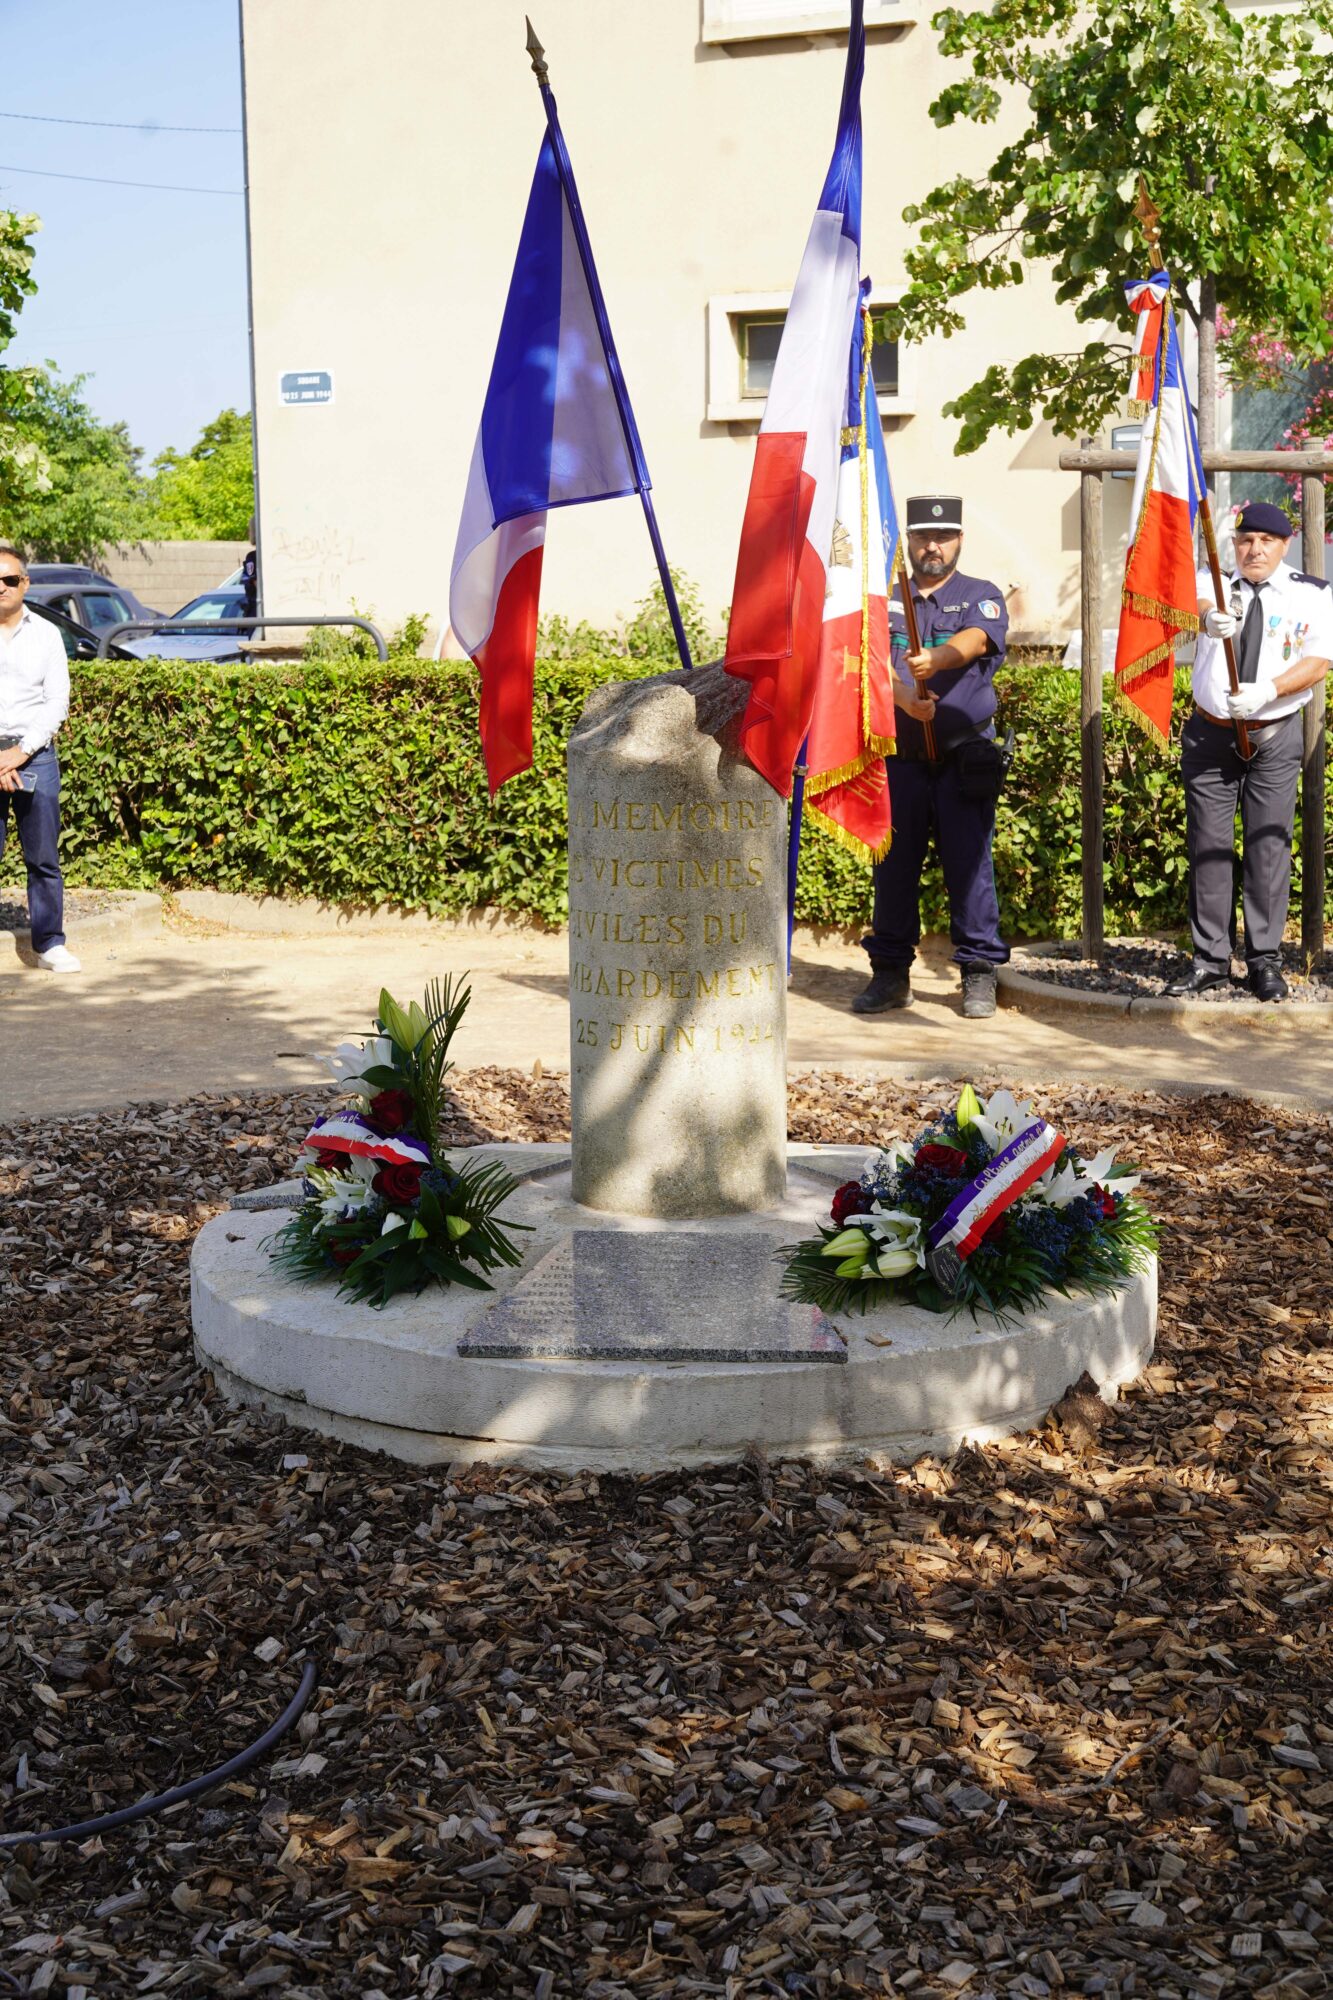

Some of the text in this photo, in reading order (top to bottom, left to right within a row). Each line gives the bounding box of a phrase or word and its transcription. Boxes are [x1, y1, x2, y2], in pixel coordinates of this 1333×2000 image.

[592, 799, 775, 833] MEMOIRE
[592, 857, 765, 891] VICTIMES
[571, 911, 748, 945] IVILES DU
[576, 1018, 775, 1054] 25 JUIN 1944
[973, 1156, 1011, 1191] Culture
